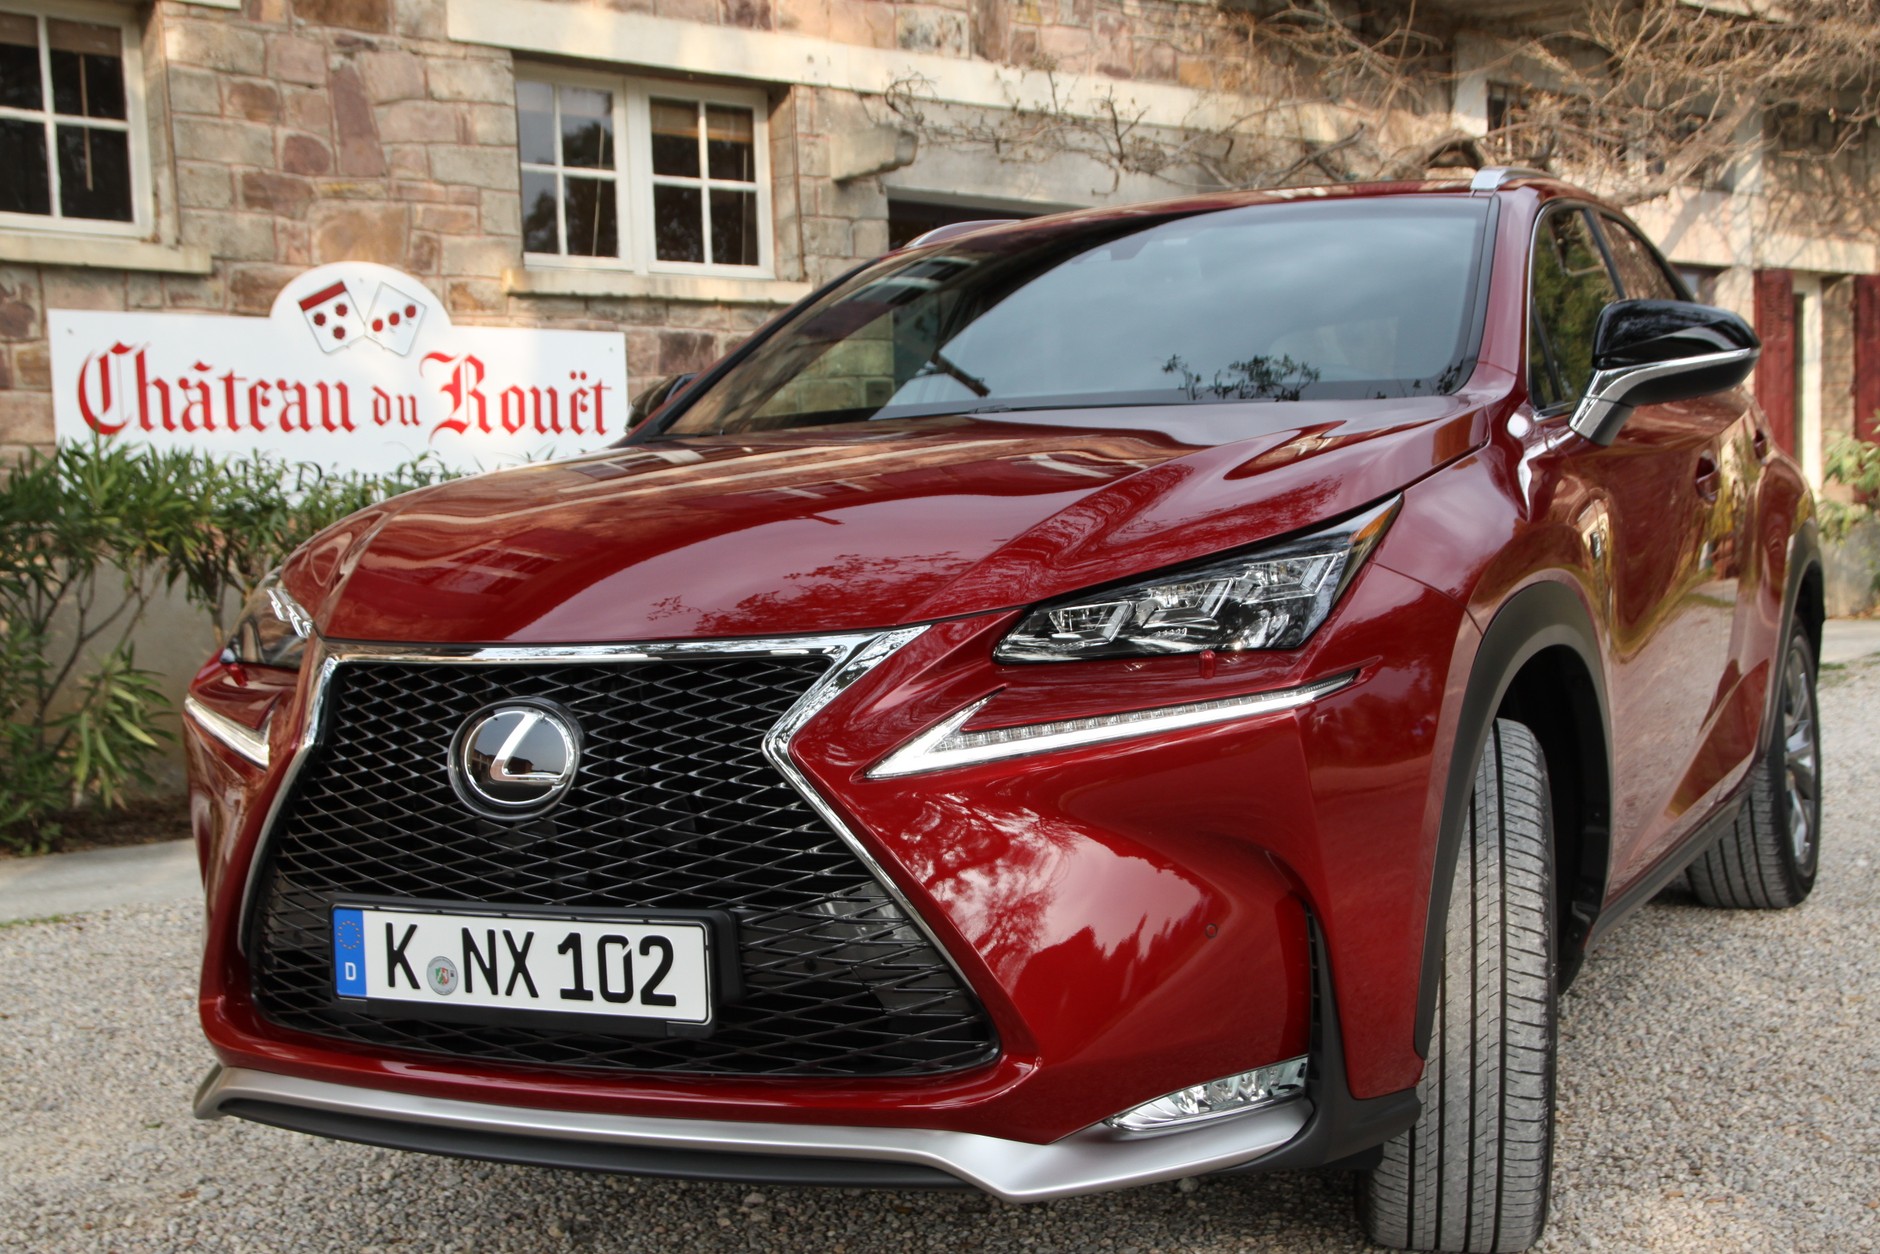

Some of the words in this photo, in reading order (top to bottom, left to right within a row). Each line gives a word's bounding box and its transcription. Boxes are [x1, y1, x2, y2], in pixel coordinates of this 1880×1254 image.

[77, 341, 359, 436] Château
[371, 385, 421, 427] du
[418, 351, 612, 445] Rouët
[345, 961, 357, 982] D
[385, 921, 421, 990] K
[461, 926, 540, 998] NX
[557, 932, 677, 1008] 102
